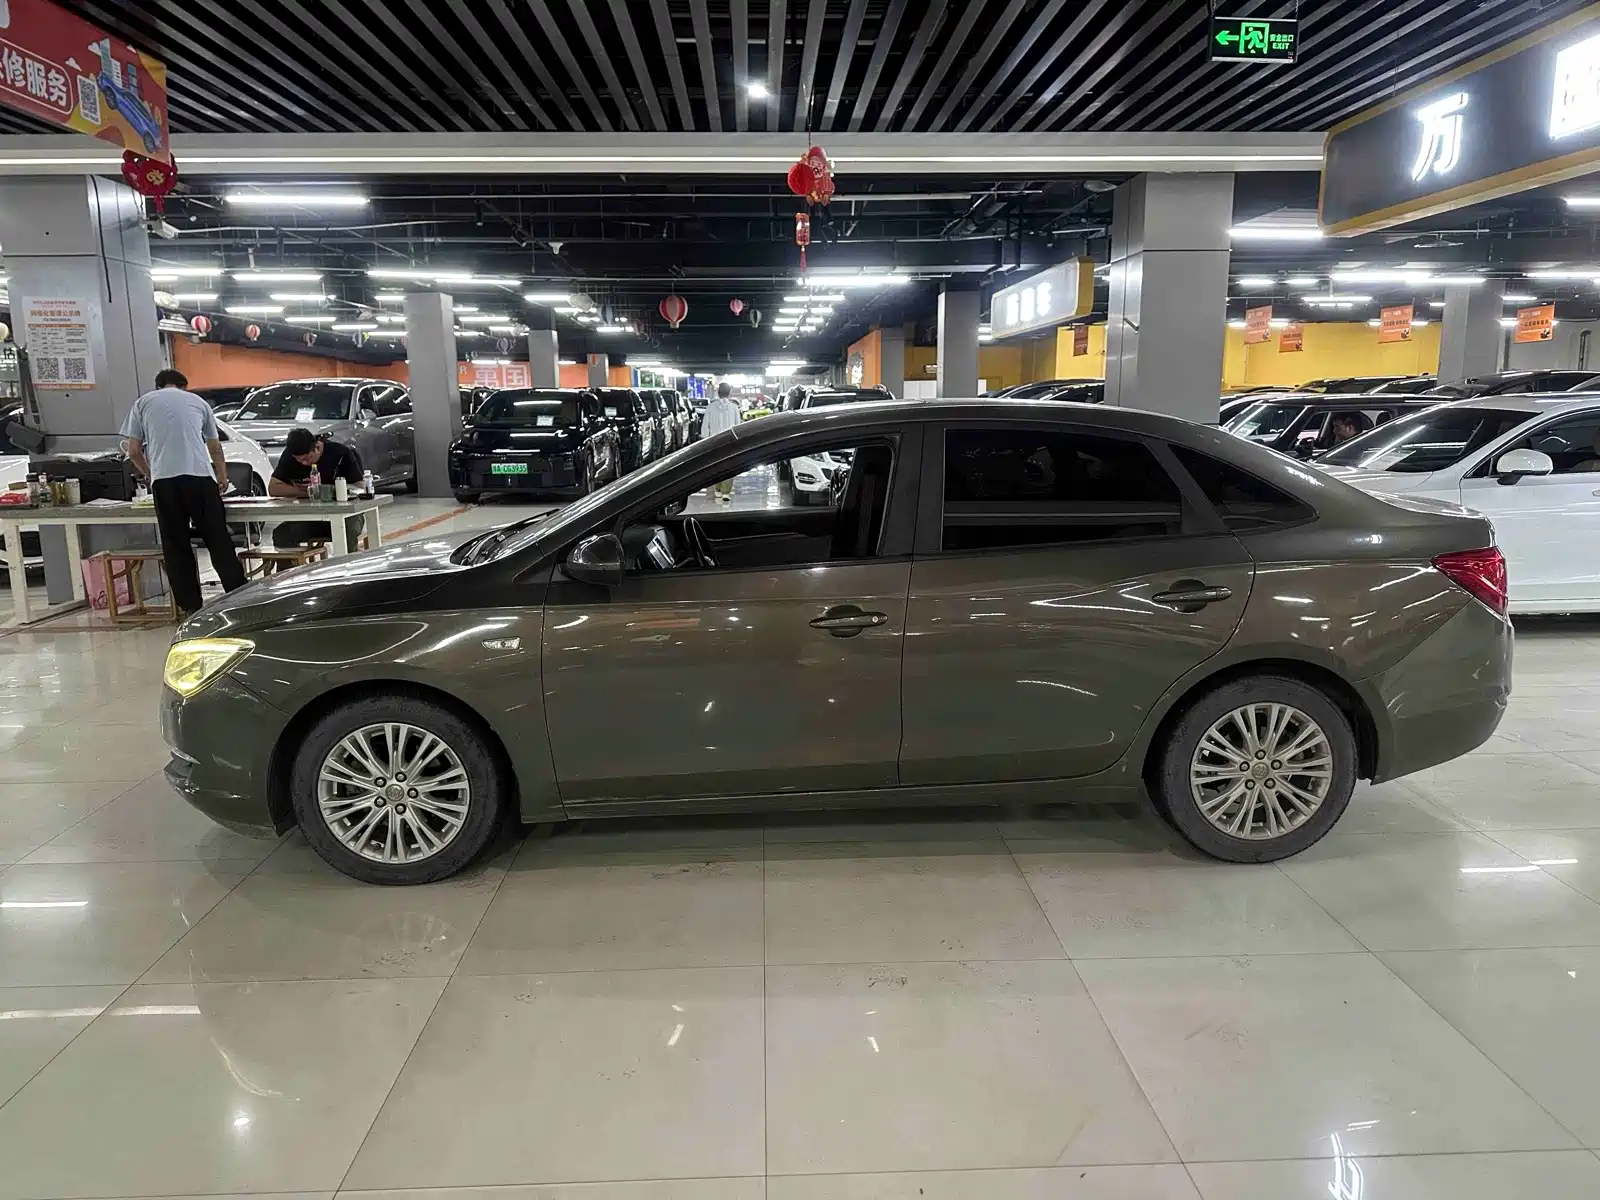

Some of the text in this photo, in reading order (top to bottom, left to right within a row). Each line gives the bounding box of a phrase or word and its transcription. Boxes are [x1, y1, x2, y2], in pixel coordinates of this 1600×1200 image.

[1269, 33, 1294, 42] 安全出口
[1272, 42, 1290, 50] EXIT
[0, 46, 67, 107] 修服务
